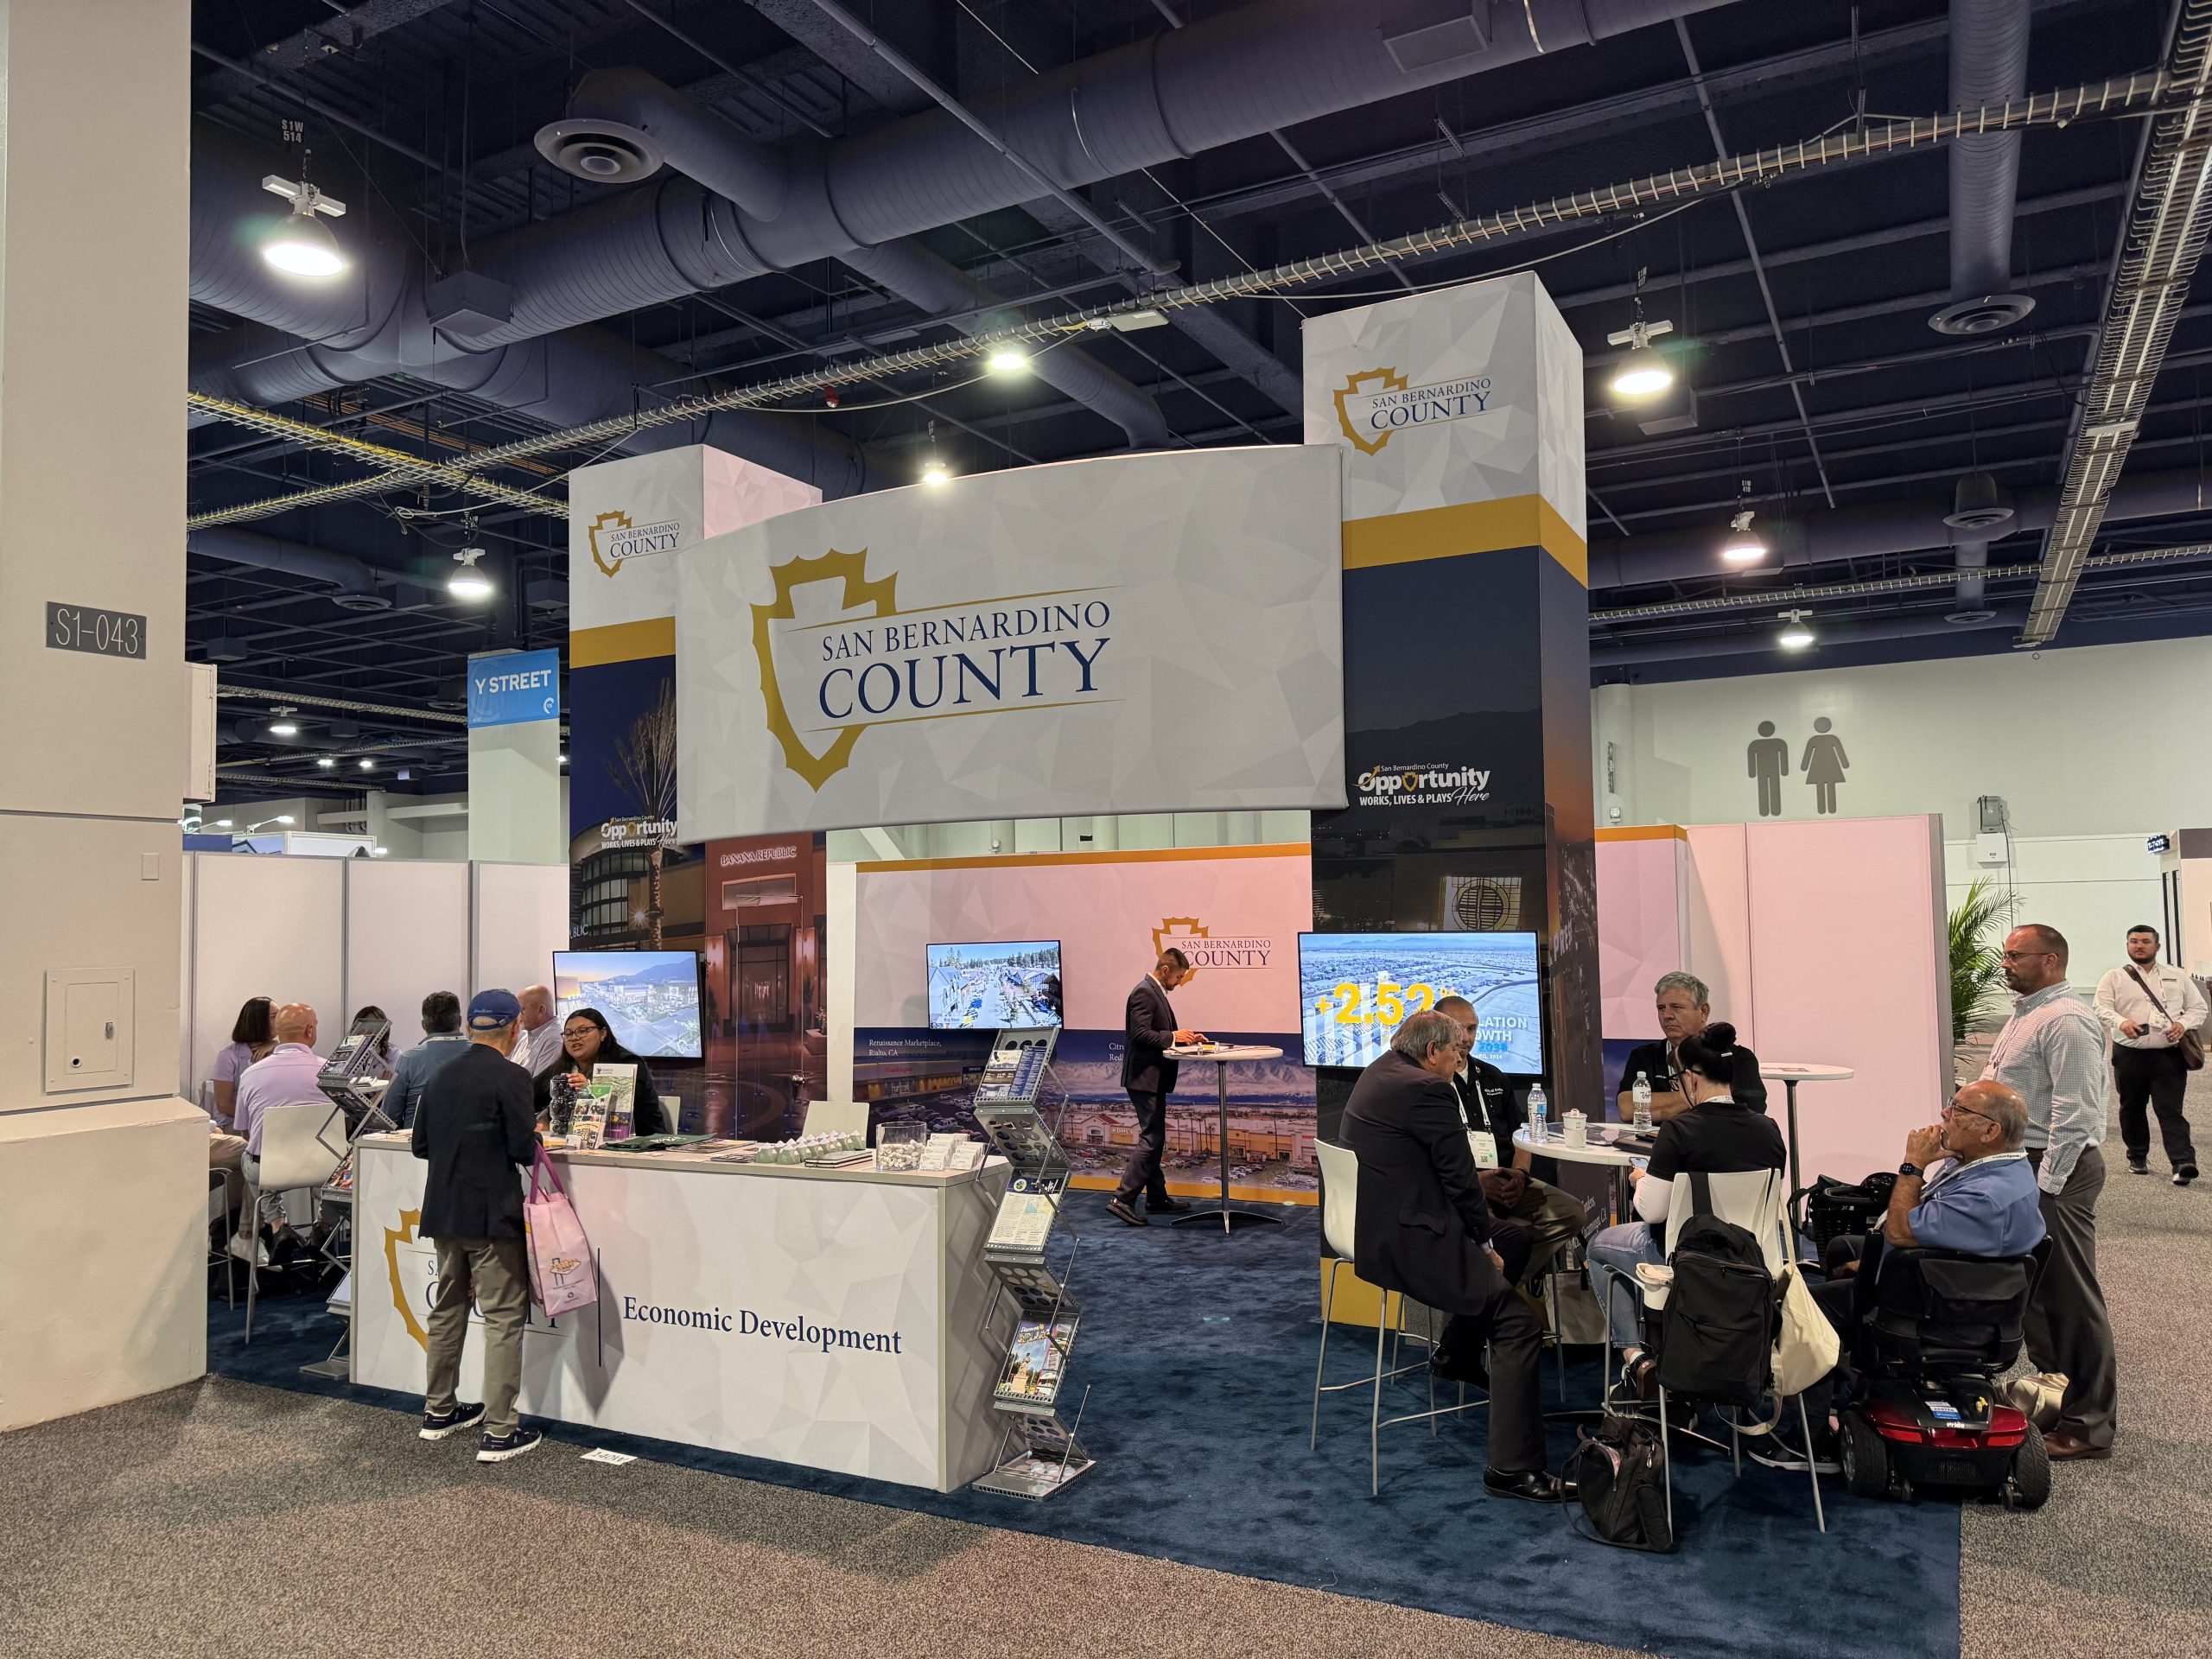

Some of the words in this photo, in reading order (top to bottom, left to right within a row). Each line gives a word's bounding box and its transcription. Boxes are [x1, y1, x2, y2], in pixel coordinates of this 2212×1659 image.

[282, 119, 303, 132] S1W
[283, 130, 302, 143] 514
[1372, 395, 1398, 409] SAN
[1402, 378, 1491, 404] BERNARDINO
[1370, 391, 1491, 429] COUNTY
[610, 531, 626, 543] SAN
[628, 522, 680, 539] BERNARDINO
[610, 531, 680, 558] COUNTY
[55, 608, 138, 655] S1-043
[823, 630, 873, 662] SAN
[885, 601, 1110, 652] BERNARDINO
[474, 678, 486, 695] Y
[489, 669, 552, 694] STREET
[819, 638, 1111, 719] COUNTY
[1393, 763, 1426, 772] Bernardino
[1427, 762, 1449, 771] County
[1357, 766, 1491, 795] Opportunity
[1359, 795, 1392, 806] WORKS,
[1394, 794, 1416, 805] LIVES
[1417, 794, 1425, 804] &
[1426, 792, 1452, 804] PLAYS
[1452, 786, 1490, 806] Here
[601, 841, 621, 849] WORKS,
[721, 851, 756, 866] BANANA
[756, 847, 797, 861] REPUBLIC
[1181, 940, 1200, 949] SAN
[1204, 939, 1271, 949] BERNARDINO
[1478, 1016, 1528, 1028] LATION
[904, 1039, 942, 1048] Marketplace,
[1476, 1030, 1512, 1041] OWTH
[623, 1296, 733, 1332] Economic
[739, 1307, 903, 1355] Development
